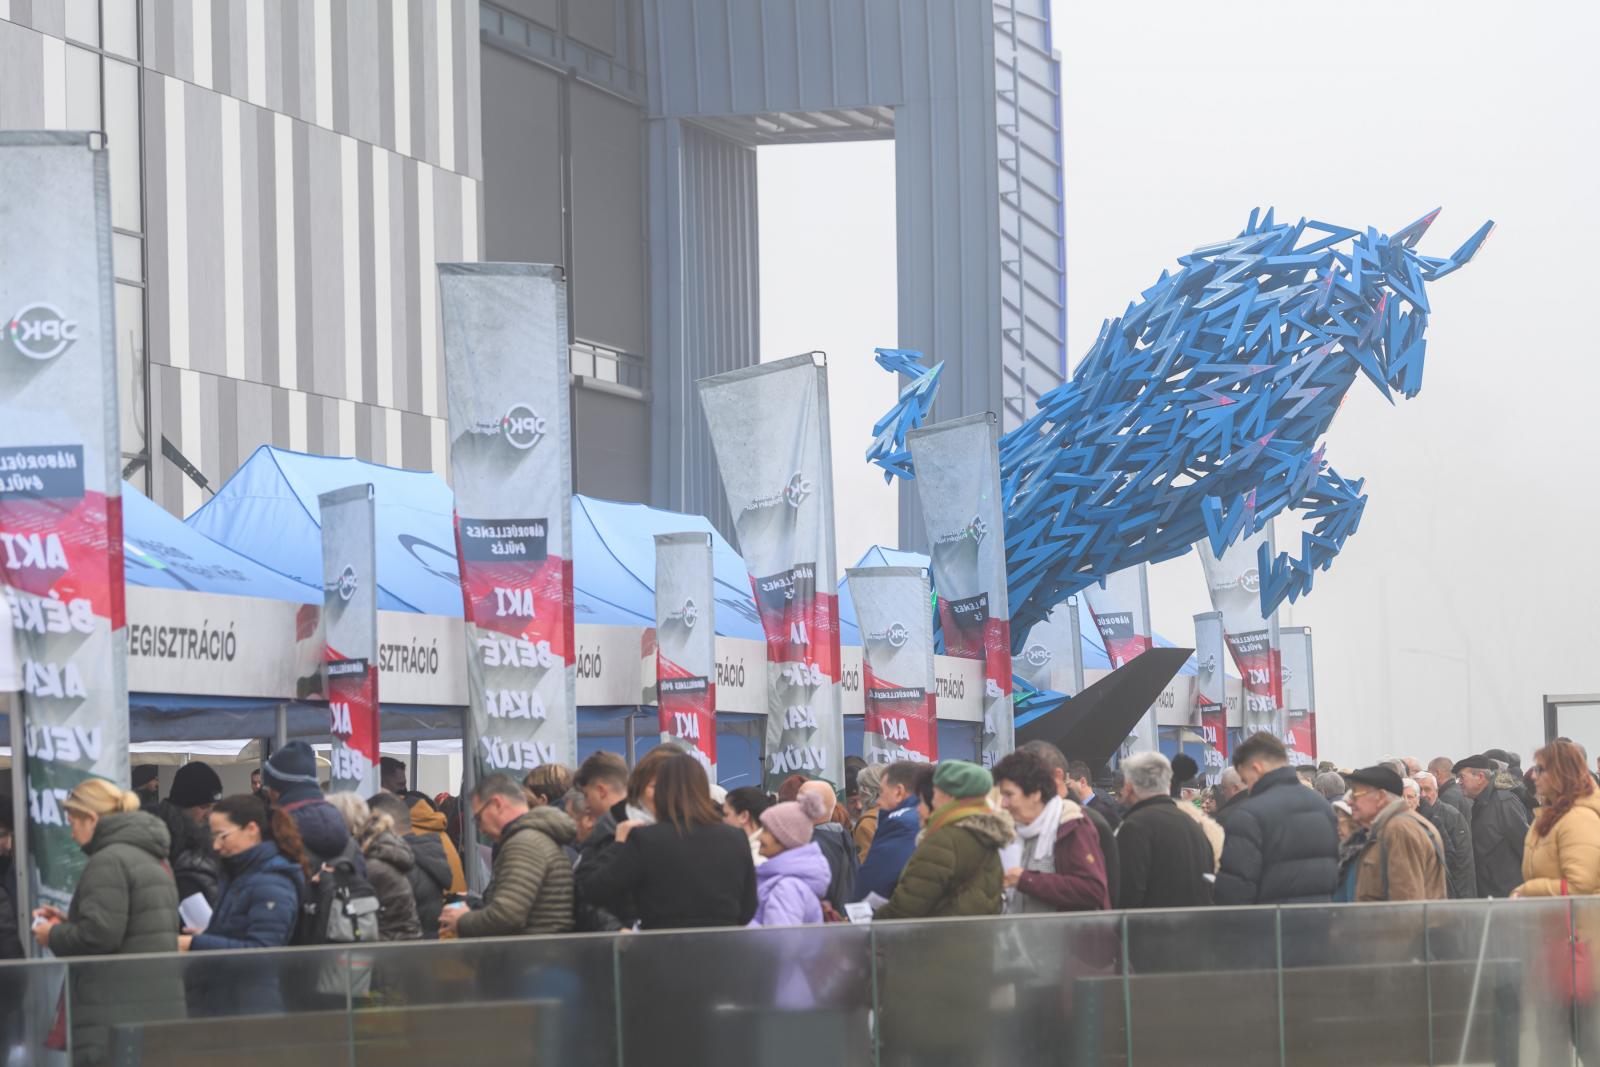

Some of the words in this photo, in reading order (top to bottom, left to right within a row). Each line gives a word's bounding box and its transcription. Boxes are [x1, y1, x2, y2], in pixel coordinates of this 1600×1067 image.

[127, 619, 236, 662] EGISZTRÁCIÓ
[379, 636, 438, 675] SZTRÁCIÓ
[576, 644, 602, 679] ÁCIÓ
